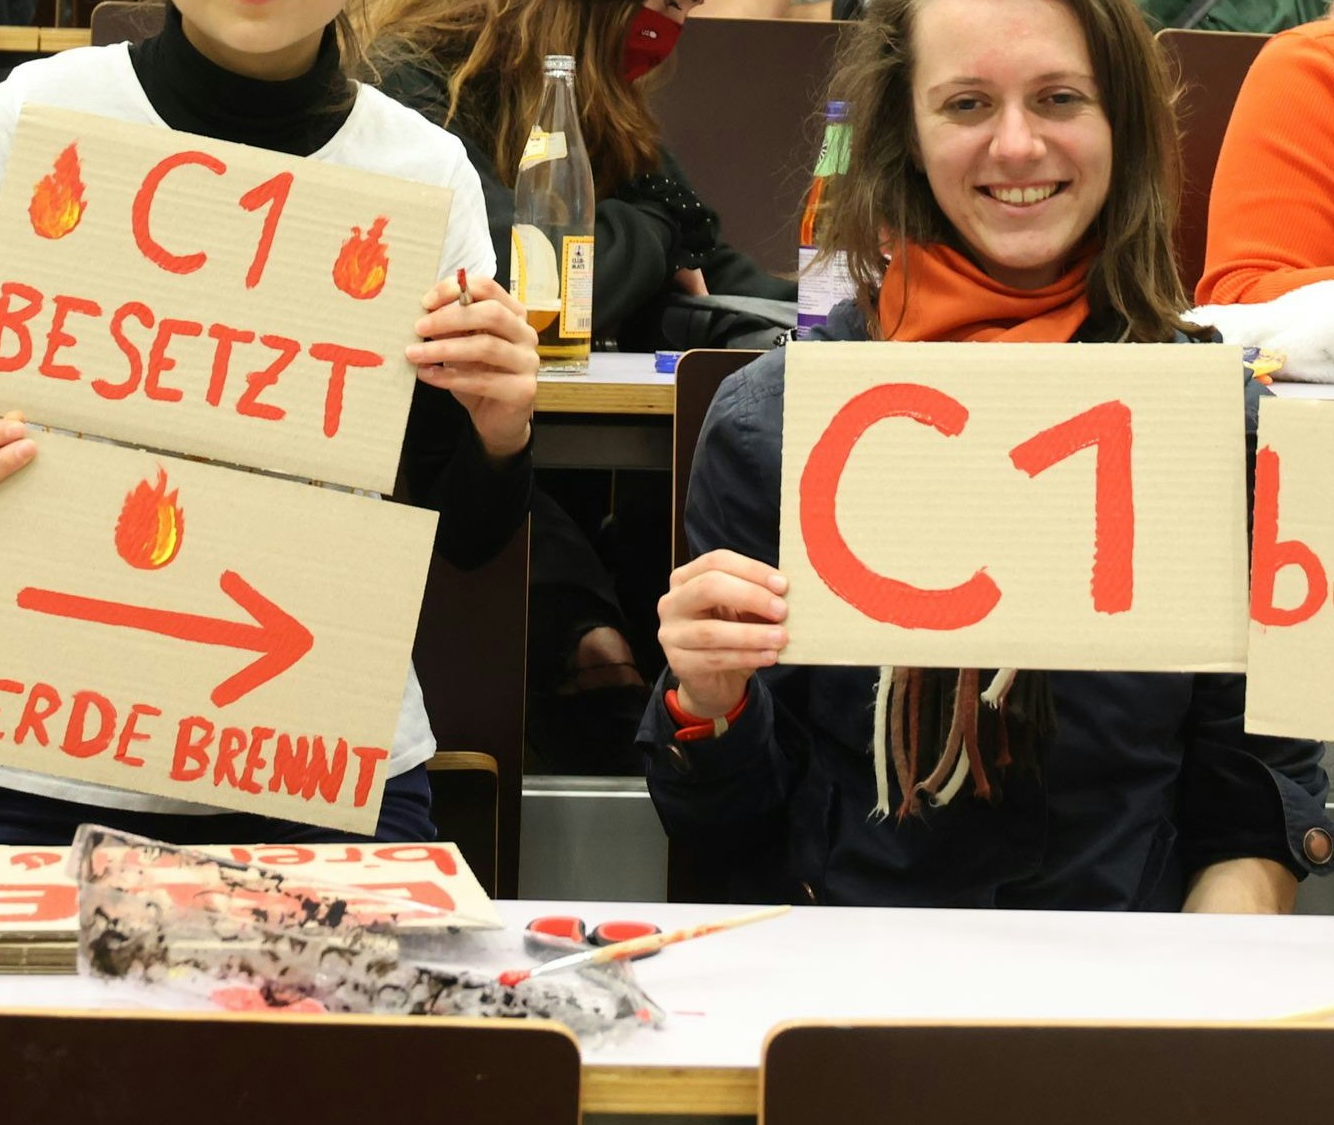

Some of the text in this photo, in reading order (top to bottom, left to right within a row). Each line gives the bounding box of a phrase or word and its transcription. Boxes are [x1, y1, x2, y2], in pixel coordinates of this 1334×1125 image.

[131, 150, 295, 290] C1
[798, 382, 1135, 631] C1
[169, 716, 388, 808] BRENNT
